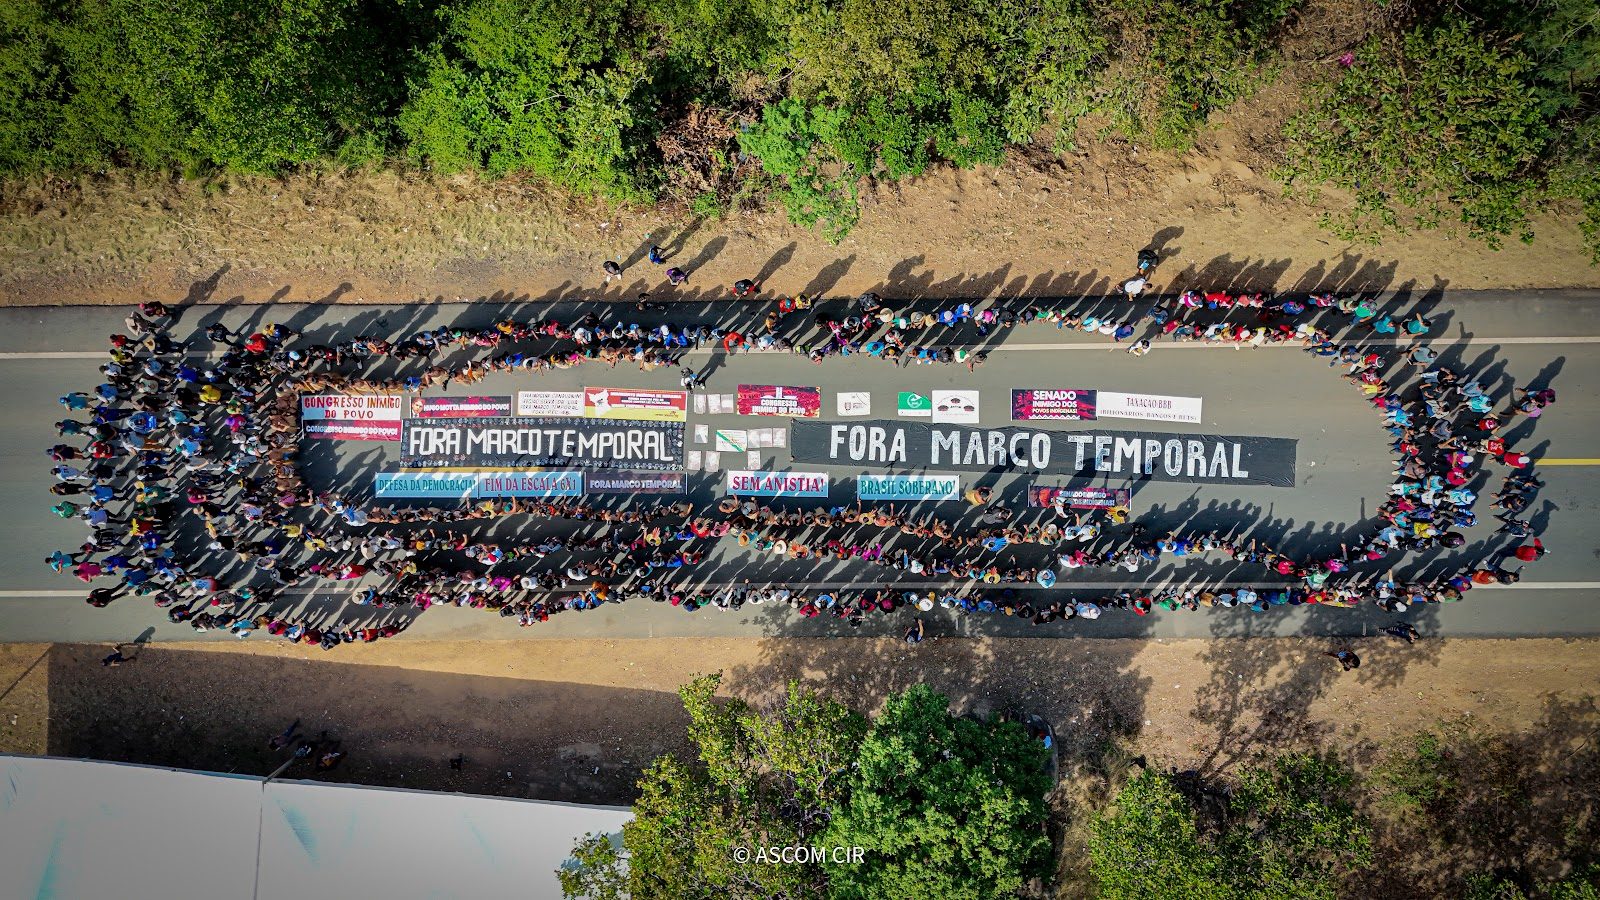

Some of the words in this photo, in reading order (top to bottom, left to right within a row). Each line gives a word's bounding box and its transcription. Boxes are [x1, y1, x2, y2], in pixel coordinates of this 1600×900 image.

[1033, 390, 1076, 400] SENADO
[304, 396, 363, 408] CONGRESSO
[367, 397, 400, 408] INIMIGO
[1032, 400, 1061, 408] INIMIGO
[1158, 400, 1172, 409] BBB
[324, 410, 336, 418] DO
[344, 410, 374, 418] POVO
[343, 426, 368, 434] INIMIGO
[378, 427, 397, 435] POVO!
[410, 427, 460, 456] FORA
[466, 428, 542, 456] MARCO
[543, 430, 674, 462] TEMPORAL
[830, 425, 906, 462] FORA
[931, 430, 1051, 469] MARCO
[1068, 436, 1248, 478] TEMPORAL
[379, 480, 408, 491] DEFESA
[410, 480, 421, 491] DA
[423, 480, 476, 491] DEMOCRACIA!
[485, 478, 502, 491] FIM
[505, 478, 518, 491] DA
[521, 478, 557, 491] ESCALA
[560, 478, 576, 490] 6X1
[590, 480, 611, 488] FORA
[612, 480, 641, 488] MARCO
[641, 480, 682, 489] TEMPORAL
[732, 476, 760, 491] SEM
[764, 477, 824, 492] ANISTIA!
[860, 480, 896, 494] BRASIL
[898, 480, 956, 495] SOBERANO!
